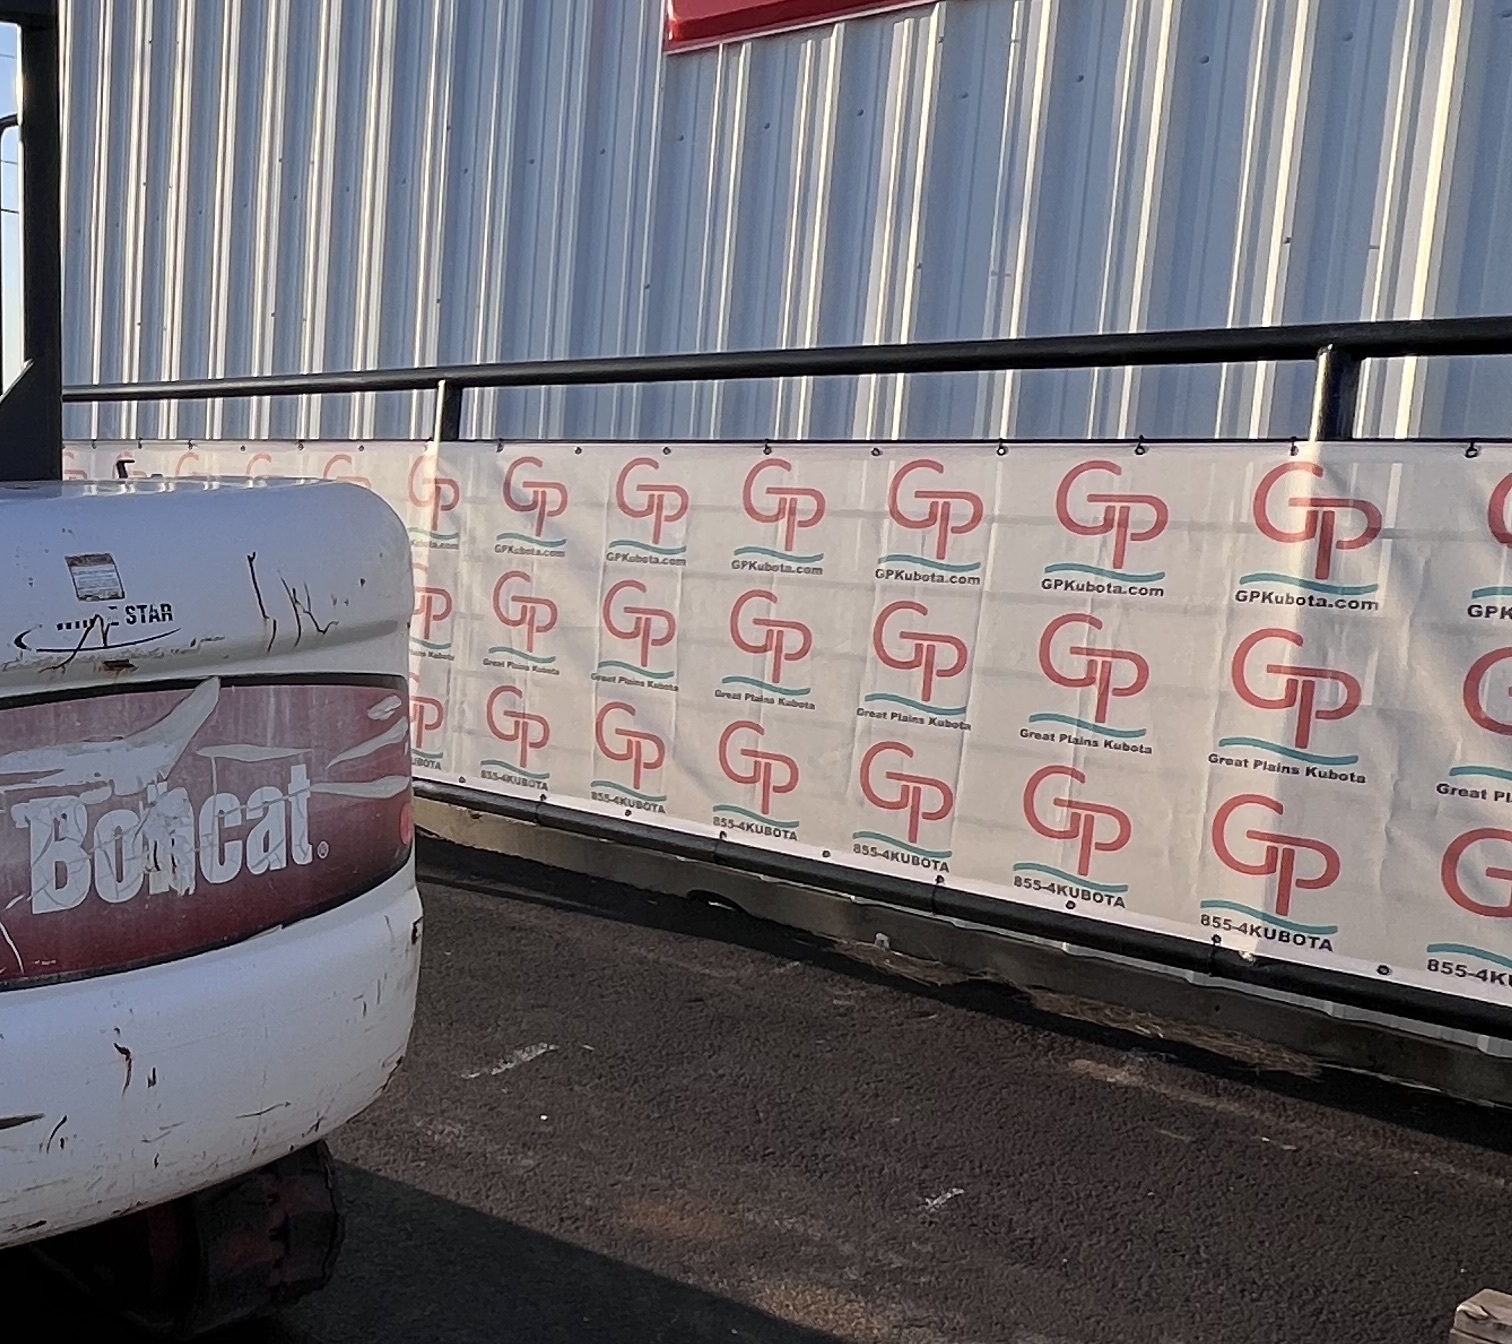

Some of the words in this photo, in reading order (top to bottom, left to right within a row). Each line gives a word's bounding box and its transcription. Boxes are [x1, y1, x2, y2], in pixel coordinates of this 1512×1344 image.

[732, 560, 823, 575] GPKubota.com
[875, 569, 980, 585] GPKubota.com
[1041, 578, 1165, 596] GPKubota.com
[1236, 590, 1379, 610] GPKubota.com
[125, 603, 174, 625] STAR
[856, 708, 887, 720] Great
[890, 712, 925, 725] Plains
[928, 716, 971, 731] Kubota
[1020, 729, 1055, 741] Great
[1059, 734, 1099, 747] Plains
[1103, 739, 1152, 754] Kubota
[1208, 753, 1248, 768] Great
[1253, 759, 1300, 775] Plains
[1305, 766, 1366, 784] Kubota
[1436, 783, 1487, 801] Great
[713, 816, 798, 841] 855-4KUBOTA
[853, 844, 950, 873] 855-4KUBOTA
[1013, 875, 1126, 909] 855-4KUBOTA
[1200, 914, 1334, 952] 855-4KUBOTA
